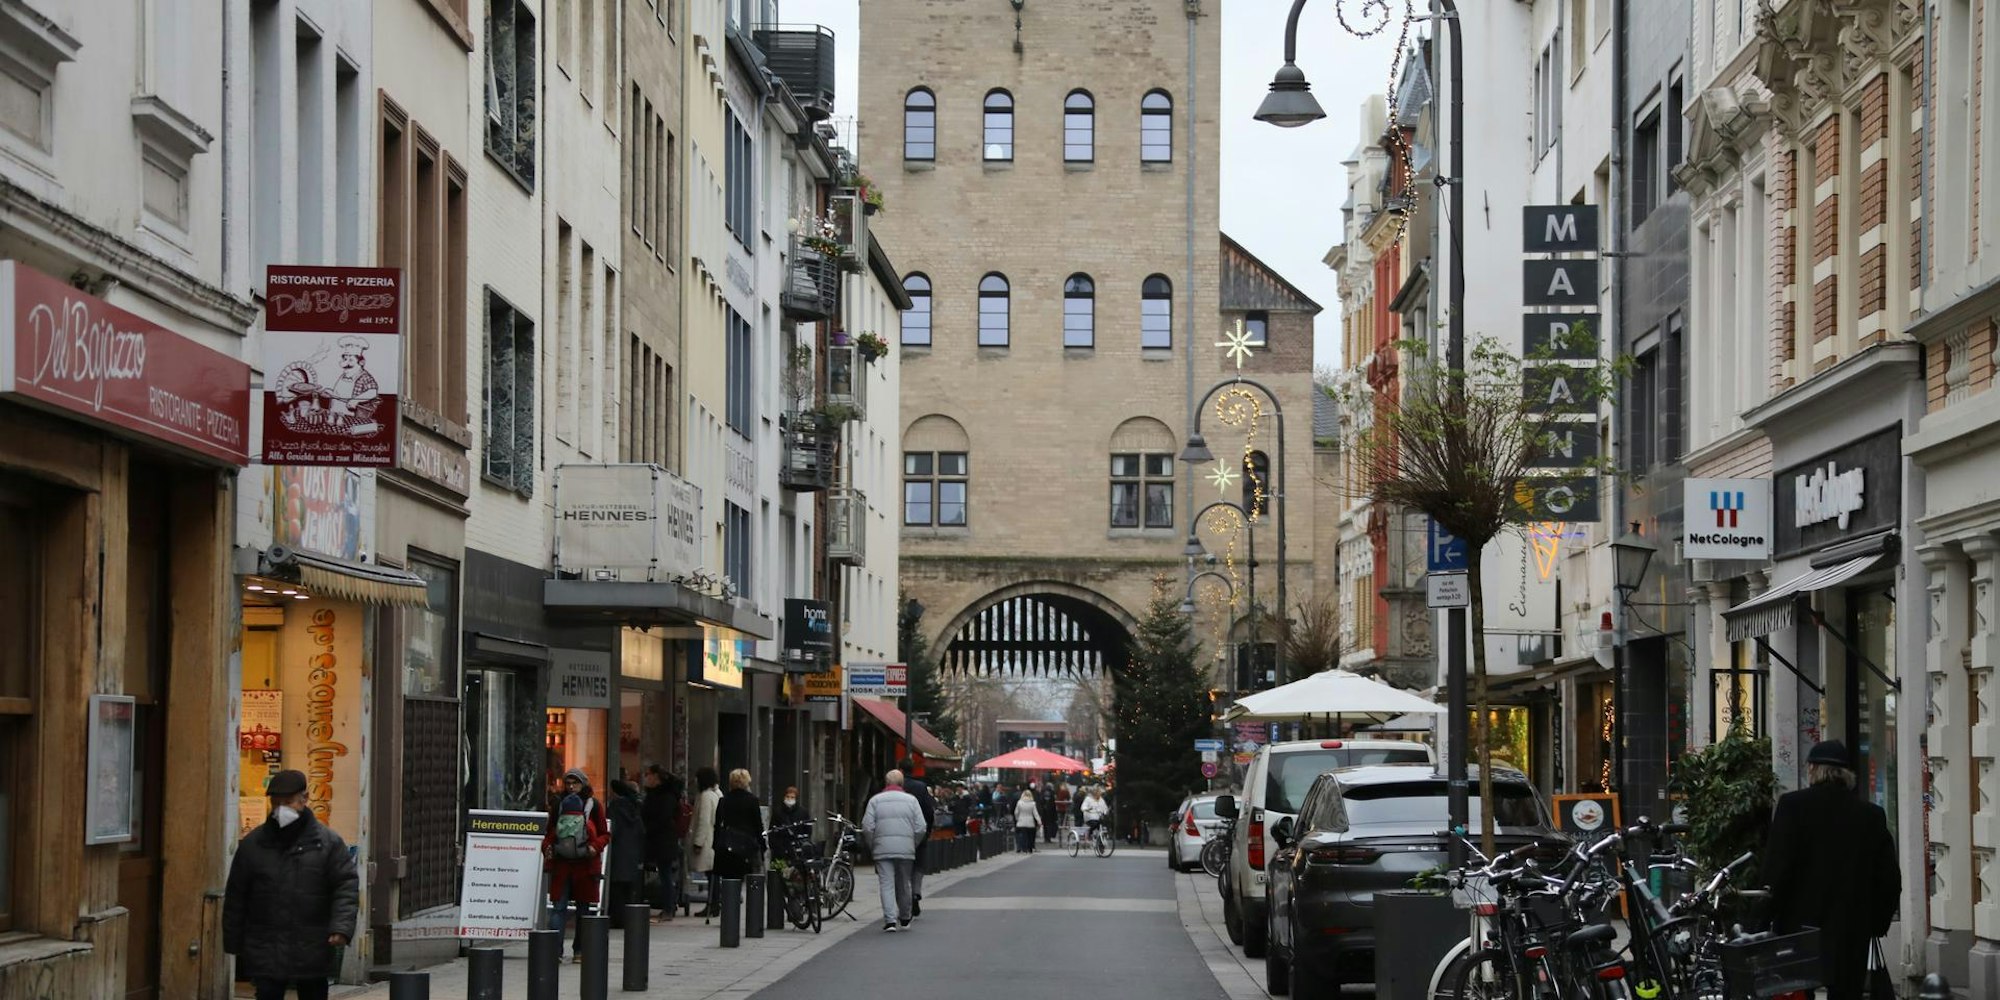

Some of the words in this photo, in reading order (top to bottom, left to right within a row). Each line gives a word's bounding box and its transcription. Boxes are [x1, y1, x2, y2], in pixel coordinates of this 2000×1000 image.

[270, 275, 338, 286] RISTORANTE
[346, 277, 395, 287] PIZZERIA
[270, 290, 313, 316] Del
[312, 290, 395, 323] Bajazzo
[29, 297, 69, 386] Del
[71, 301, 146, 411] Bajazzo
[149, 387, 201, 432] RISTORANTE
[206, 408, 241, 446] PIZZERIA
[564, 510, 647, 520] HENNES
[1690, 533, 1764, 547] NetCologne
[562, 675, 607, 697] HENNES
[472, 819, 540, 832] Herrenmode
